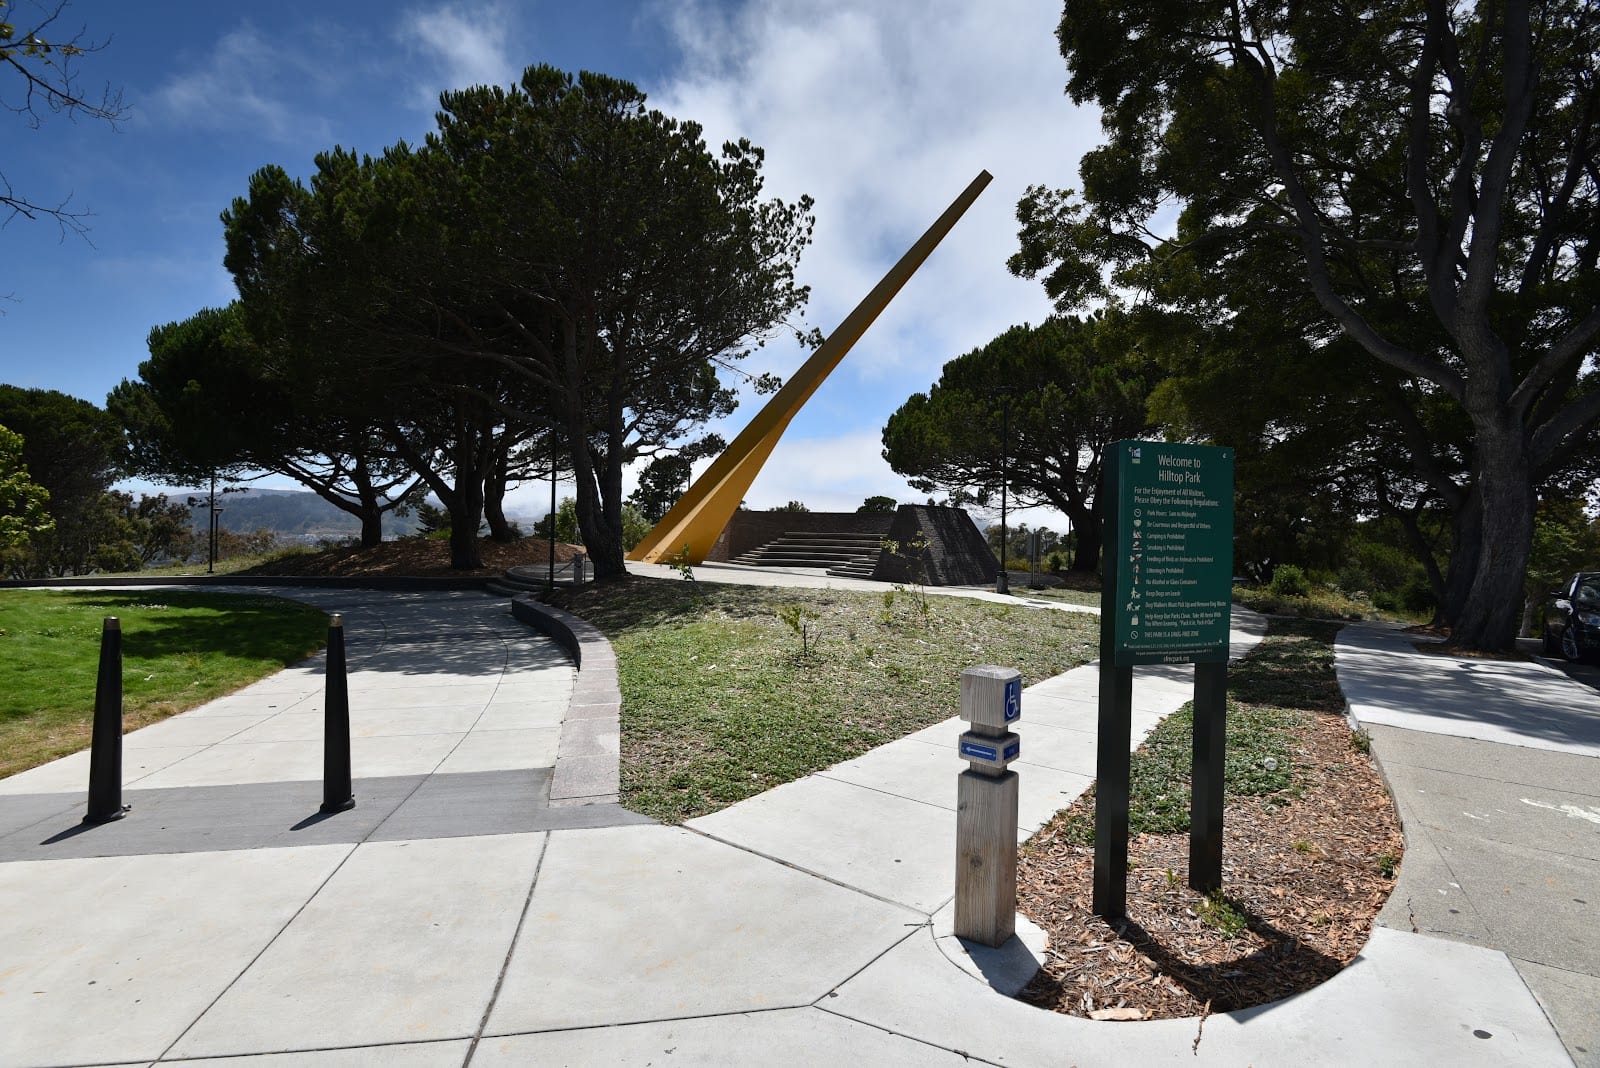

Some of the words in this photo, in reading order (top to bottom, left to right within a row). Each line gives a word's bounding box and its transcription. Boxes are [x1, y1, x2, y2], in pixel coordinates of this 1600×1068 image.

[1158, 454, 1192, 468] Welcome
[1193, 458, 1201, 469] to
[1158, 470, 1184, 485] Hilltop
[1185, 471, 1201, 484] Park
[1142, 487, 1151, 495] the
[1151, 487, 1176, 497] Enjoyment
[1134, 496, 1149, 504] Please
[1150, 497, 1162, 506] Obey
[1163, 497, 1171, 505] the
[1171, 498, 1193, 508] Following
[1147, 533, 1163, 541] Camping
[1146, 544, 1163, 552] Smoking
[1146, 590, 1155, 598] Keep
[1156, 590, 1164, 598] Dogs
